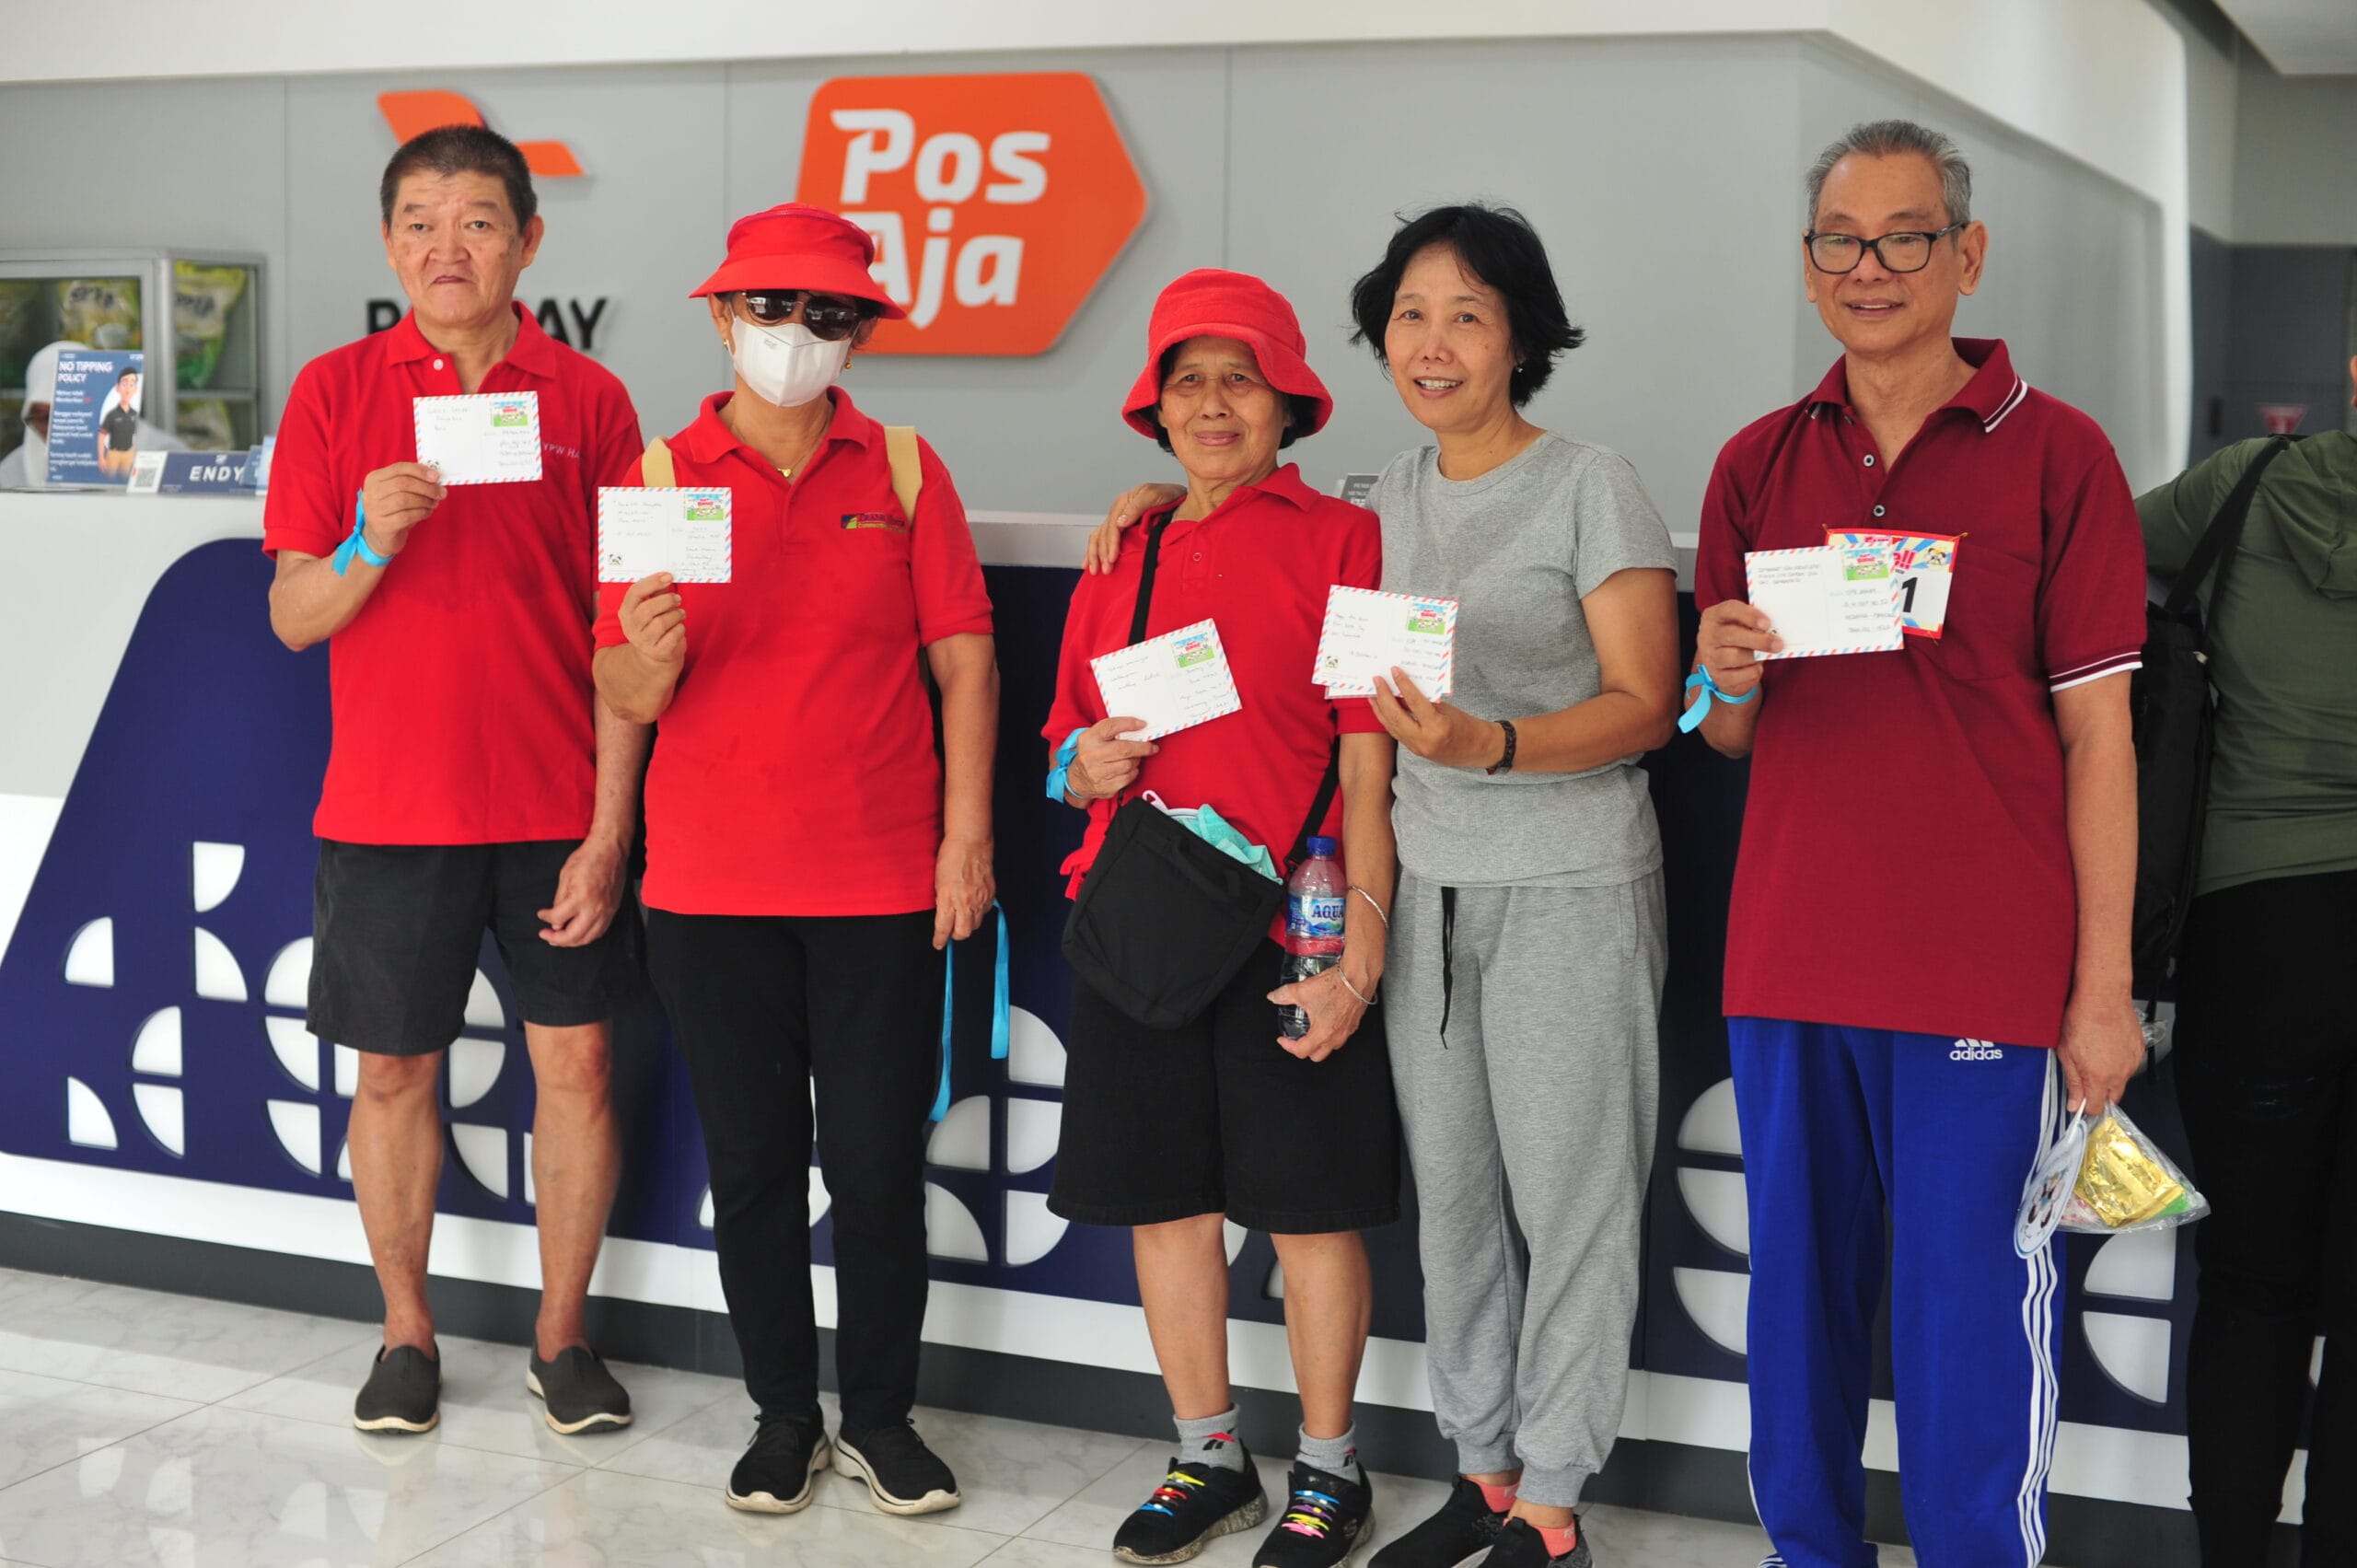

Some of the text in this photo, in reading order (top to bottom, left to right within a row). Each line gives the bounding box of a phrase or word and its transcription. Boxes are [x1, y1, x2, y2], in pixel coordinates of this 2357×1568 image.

[830, 109, 1052, 204] Pos
[839, 207, 1024, 330] Aja
[58, 361, 113, 373] NO TIPPING
[57, 373, 87, 383] POLICY
[1949, 1047, 2003, 1061] adidas
